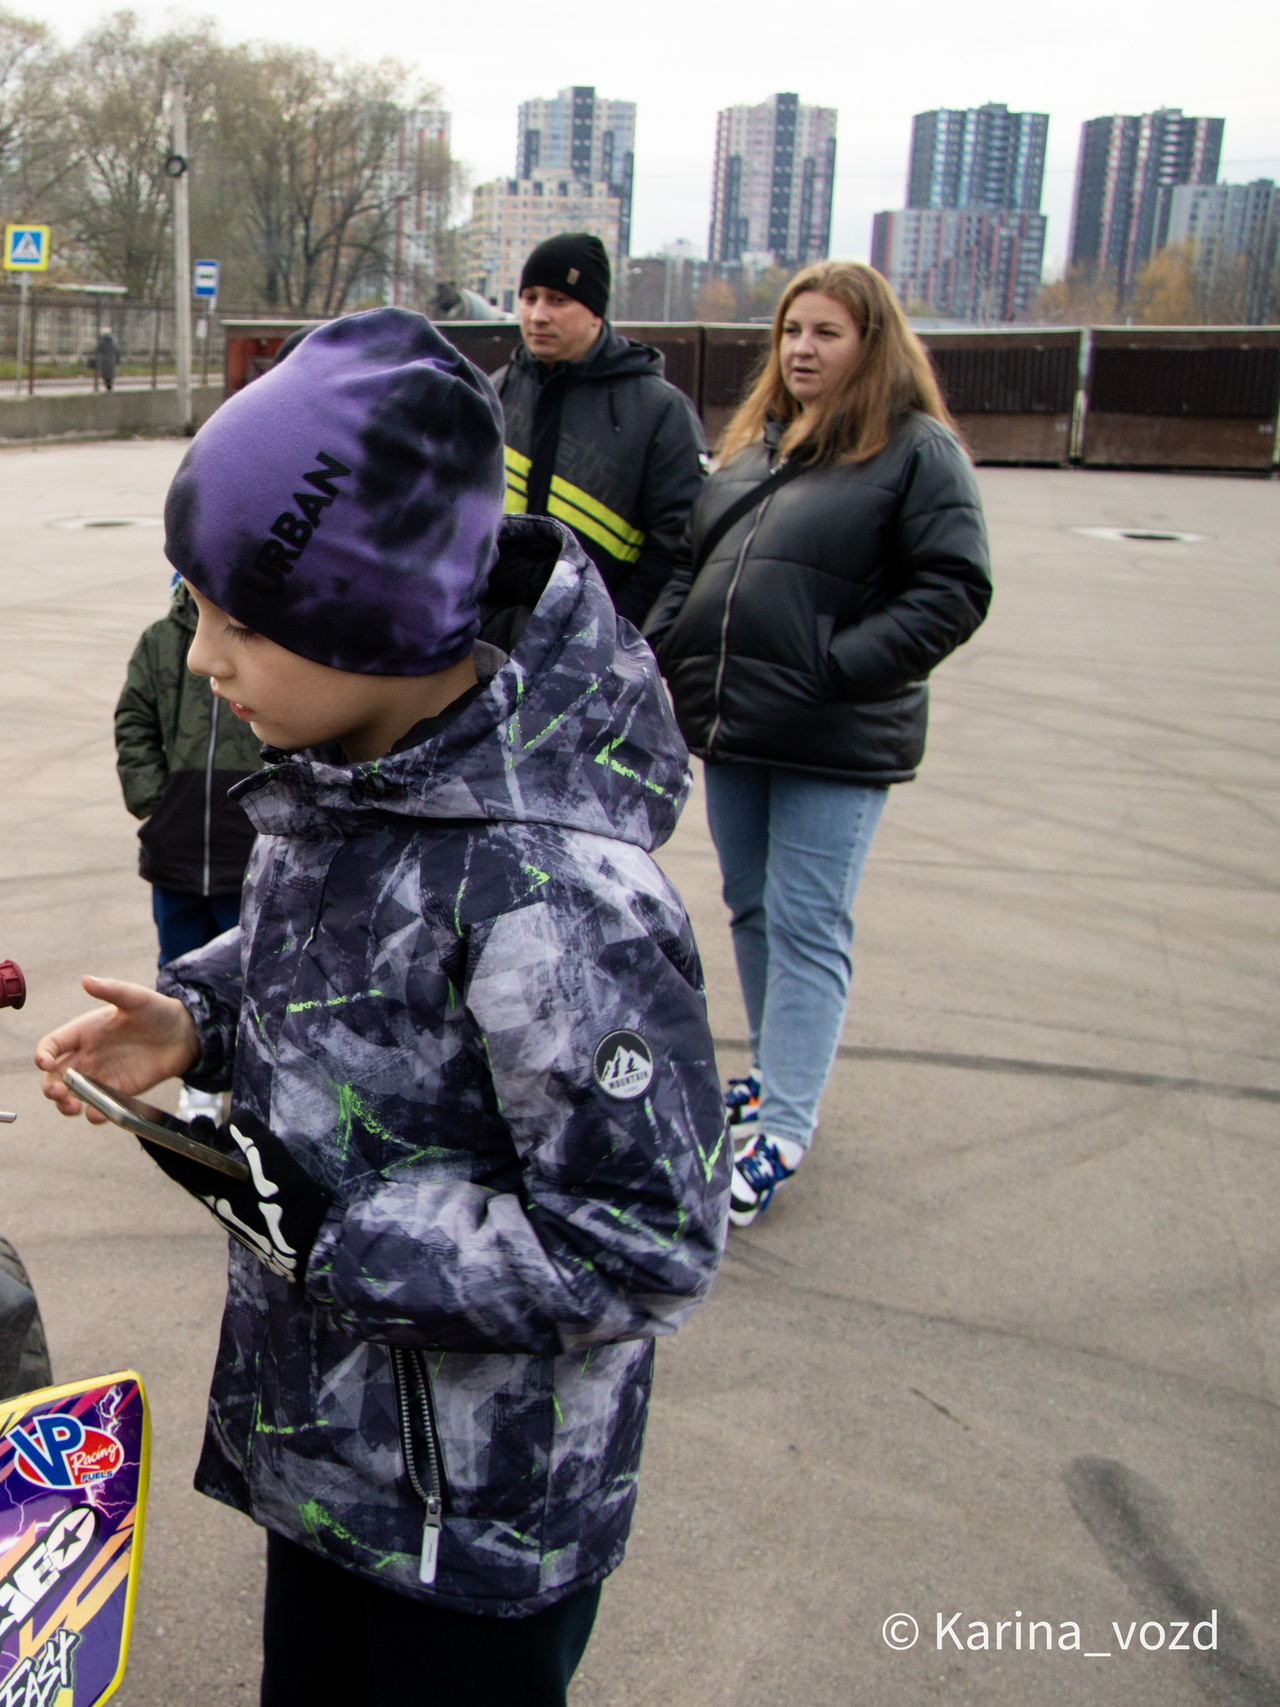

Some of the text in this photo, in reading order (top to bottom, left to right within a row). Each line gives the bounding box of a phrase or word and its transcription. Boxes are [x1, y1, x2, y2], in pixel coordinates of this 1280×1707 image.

[254, 451, 361, 599] URBAN
[5, 1413, 85, 1487] VP
[70, 1443, 119, 1476] Racing
[81, 1470, 114, 1483] FUELS
